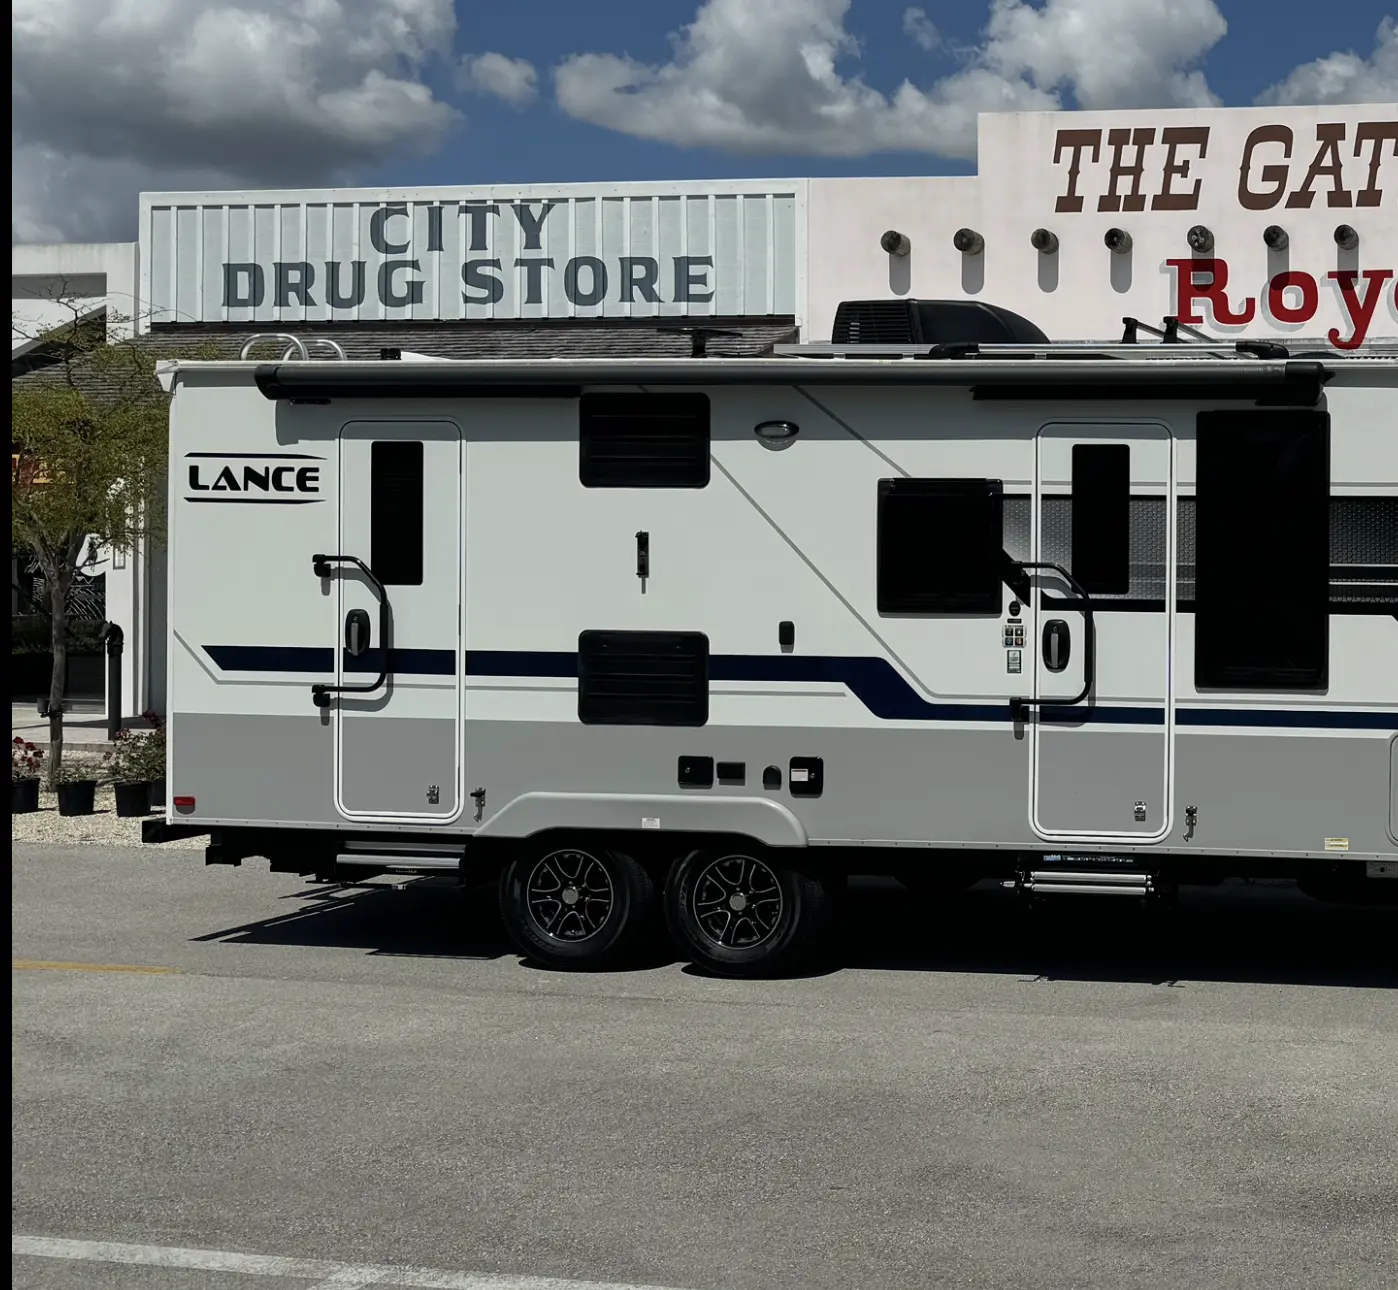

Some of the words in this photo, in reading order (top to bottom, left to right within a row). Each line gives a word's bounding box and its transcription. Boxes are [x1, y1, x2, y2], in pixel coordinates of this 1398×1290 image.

[1052, 126, 1211, 213] THE
[369, 202, 557, 255] CITY
[222, 260, 426, 310] DRUG
[461, 254, 715, 307] STORE
[188, 465, 320, 493] LANCE
